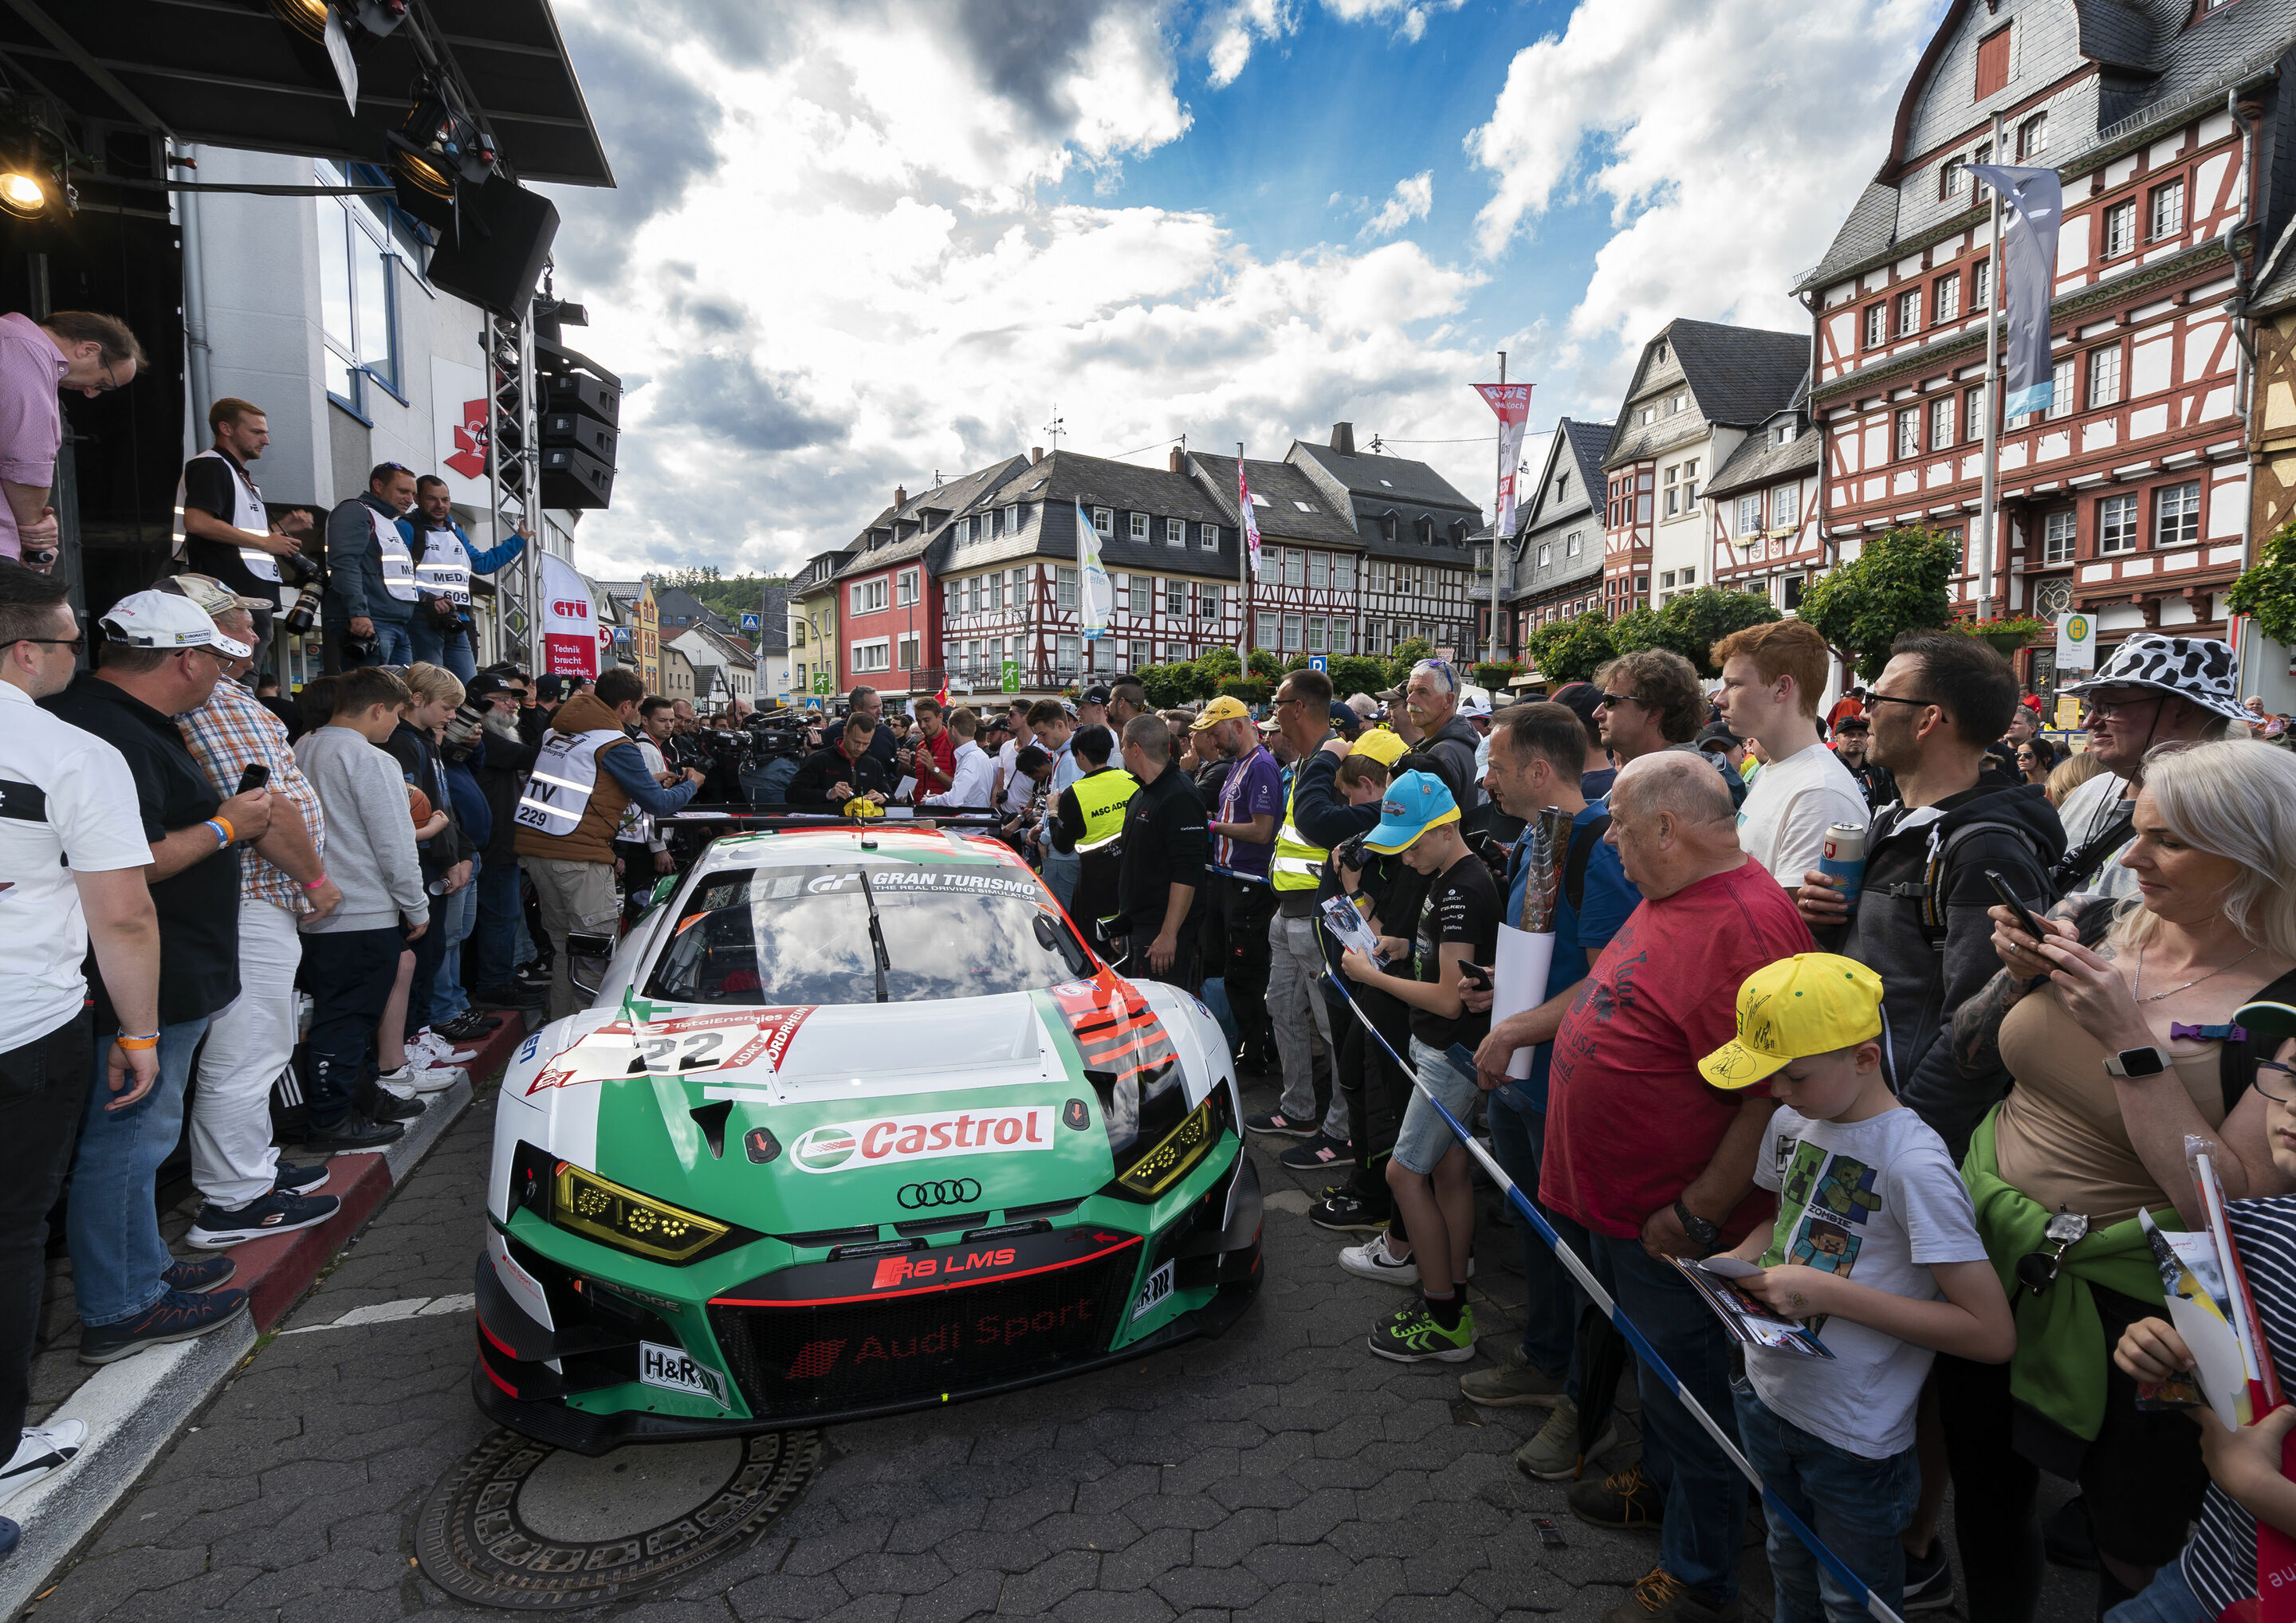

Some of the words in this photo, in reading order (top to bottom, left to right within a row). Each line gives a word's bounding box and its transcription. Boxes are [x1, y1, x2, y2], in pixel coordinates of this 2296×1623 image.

[443, 591, 469, 603] 609
[553, 599, 587, 618] GTÜ
[553, 644, 580, 654] Technik
[554, 655, 581, 665] braucht
[555, 666, 592, 676] Sicherheit.
[1312, 659, 1323, 670] P
[529, 778, 558, 803] TV
[1261, 785, 1268, 794] 3
[517, 807, 547, 826] 229
[1091, 806, 1111, 818] MSC
[872, 872, 942, 886] GRAN
[943, 874, 1036, 895] TURISMO
[977, 888, 1036, 902] SIMULATOR
[673, 1013, 783, 1029] TotalEnergies
[770, 1007, 809, 1067] ORDRHEIN
[1571, 1032, 1597, 1061] USA
[627, 1032, 723, 1075] 22
[733, 1043, 765, 1066] ADAC
[862, 1111, 1043, 1159] Castrol
[1808, 1204, 1853, 1229] ZOMBIE
[888, 1259, 938, 1283] R8
[944, 1248, 1016, 1274] LMS
[621, 1287, 682, 1313] EDGE
[854, 1321, 961, 1365] Audi
[975, 1297, 1094, 1346] Sport
[646, 1347, 698, 1385] H&R
